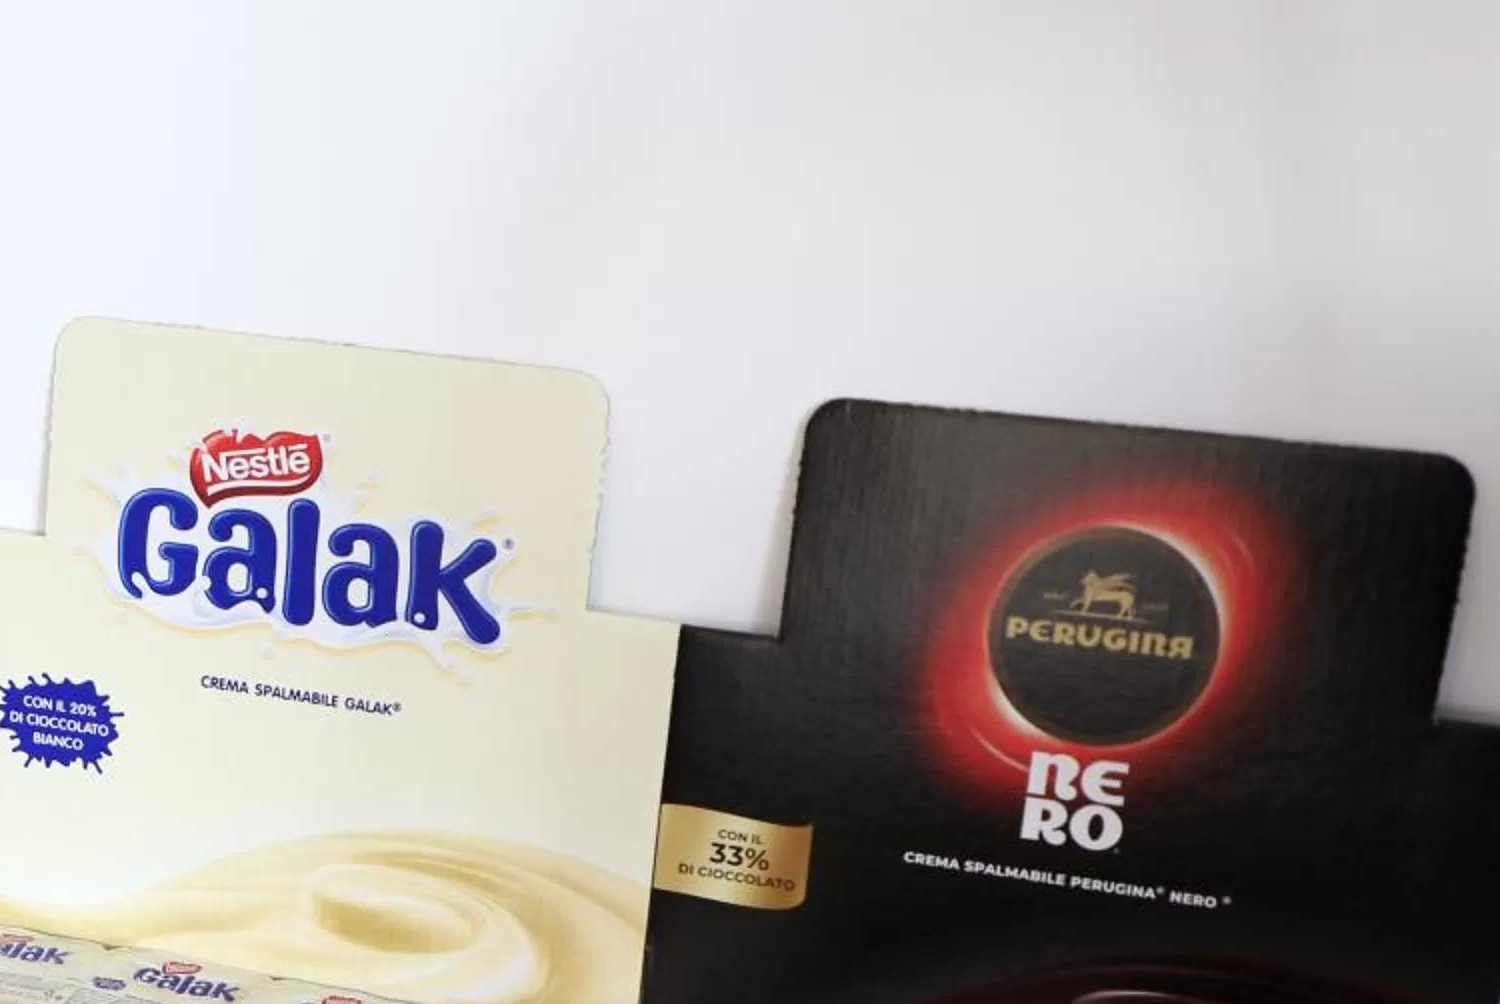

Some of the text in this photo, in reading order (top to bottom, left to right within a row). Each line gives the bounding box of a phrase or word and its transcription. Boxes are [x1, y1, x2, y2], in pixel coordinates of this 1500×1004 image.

[202, 444, 312, 484] Nestlé
[118, 487, 501, 645] Galak
[1006, 615, 1195, 661] PERUGINA
[23, 695, 98, 718] CON IL 20%
[200, 675, 249, 694] CREMA
[255, 683, 339, 708] SPALMABILE
[9, 711, 110, 738] DI CIOCCOLATO
[33, 731, 85, 751] BIANCO
[718, 829, 765, 845] CON IL
[709, 842, 770, 871] 33%
[678, 863, 797, 893] DI CIOCCOLATO
[903, 851, 961, 870] CREMA
[963, 859, 1066, 886] SPALMABILE
[1169, 889, 1218, 909] NERO
[133, 967, 240, 1002] Galak
